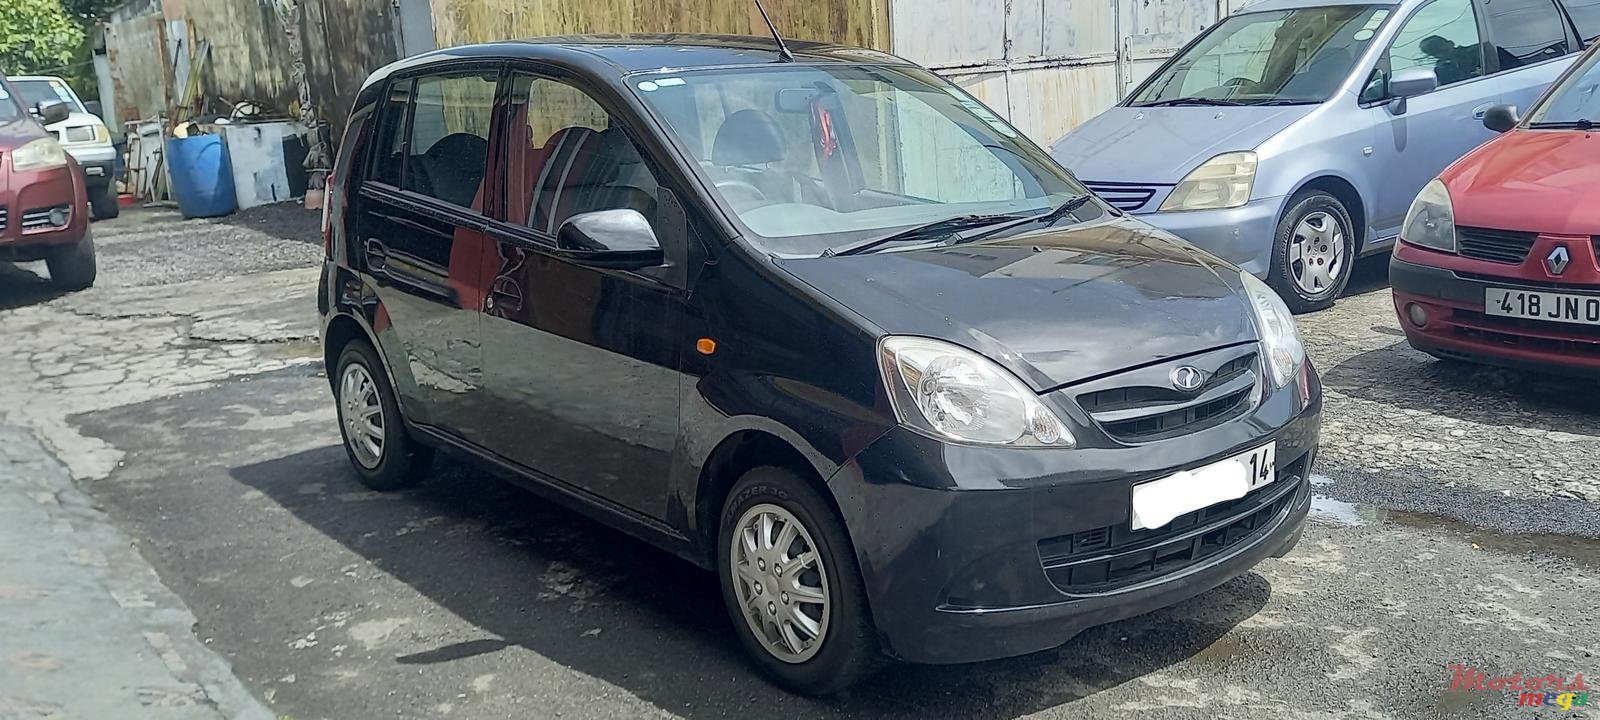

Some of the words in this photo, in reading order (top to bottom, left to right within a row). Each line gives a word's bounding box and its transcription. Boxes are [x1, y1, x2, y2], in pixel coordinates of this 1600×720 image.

[1501, 292, 1540, 317] 418
[1547, 297, 1579, 320] JN
[1250, 449, 1269, 485] 14
